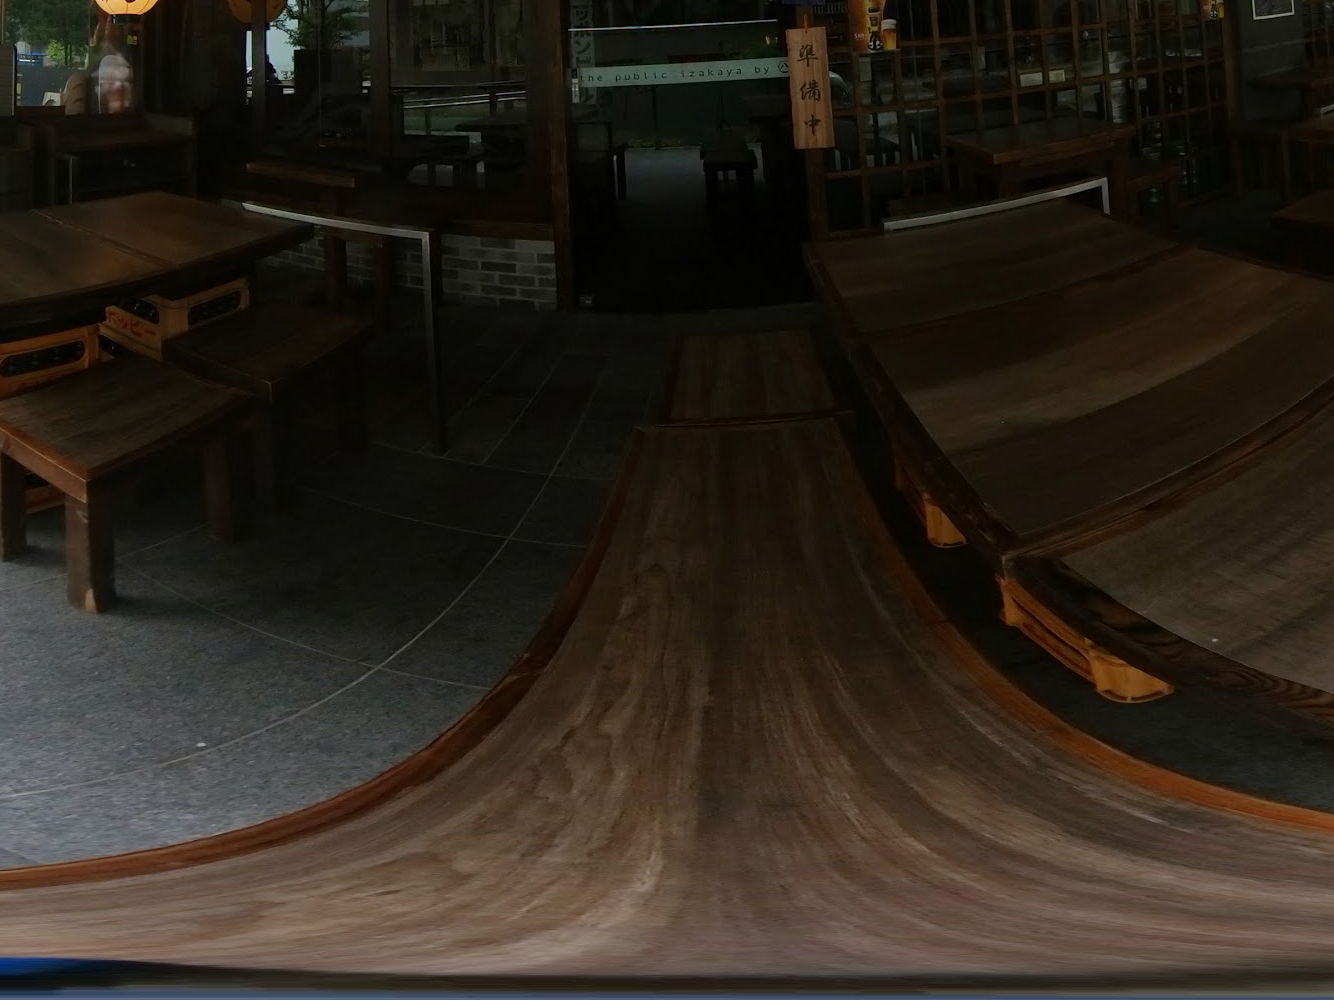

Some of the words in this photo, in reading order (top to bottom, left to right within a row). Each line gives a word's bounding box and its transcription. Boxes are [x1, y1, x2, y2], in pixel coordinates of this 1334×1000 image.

[580, 74, 603, 83] the
[615, 70, 667, 82] public
[681, 66, 742, 78] izakaya
[755, 64, 770, 75] by
[797, 44, 821, 136] 準備中
